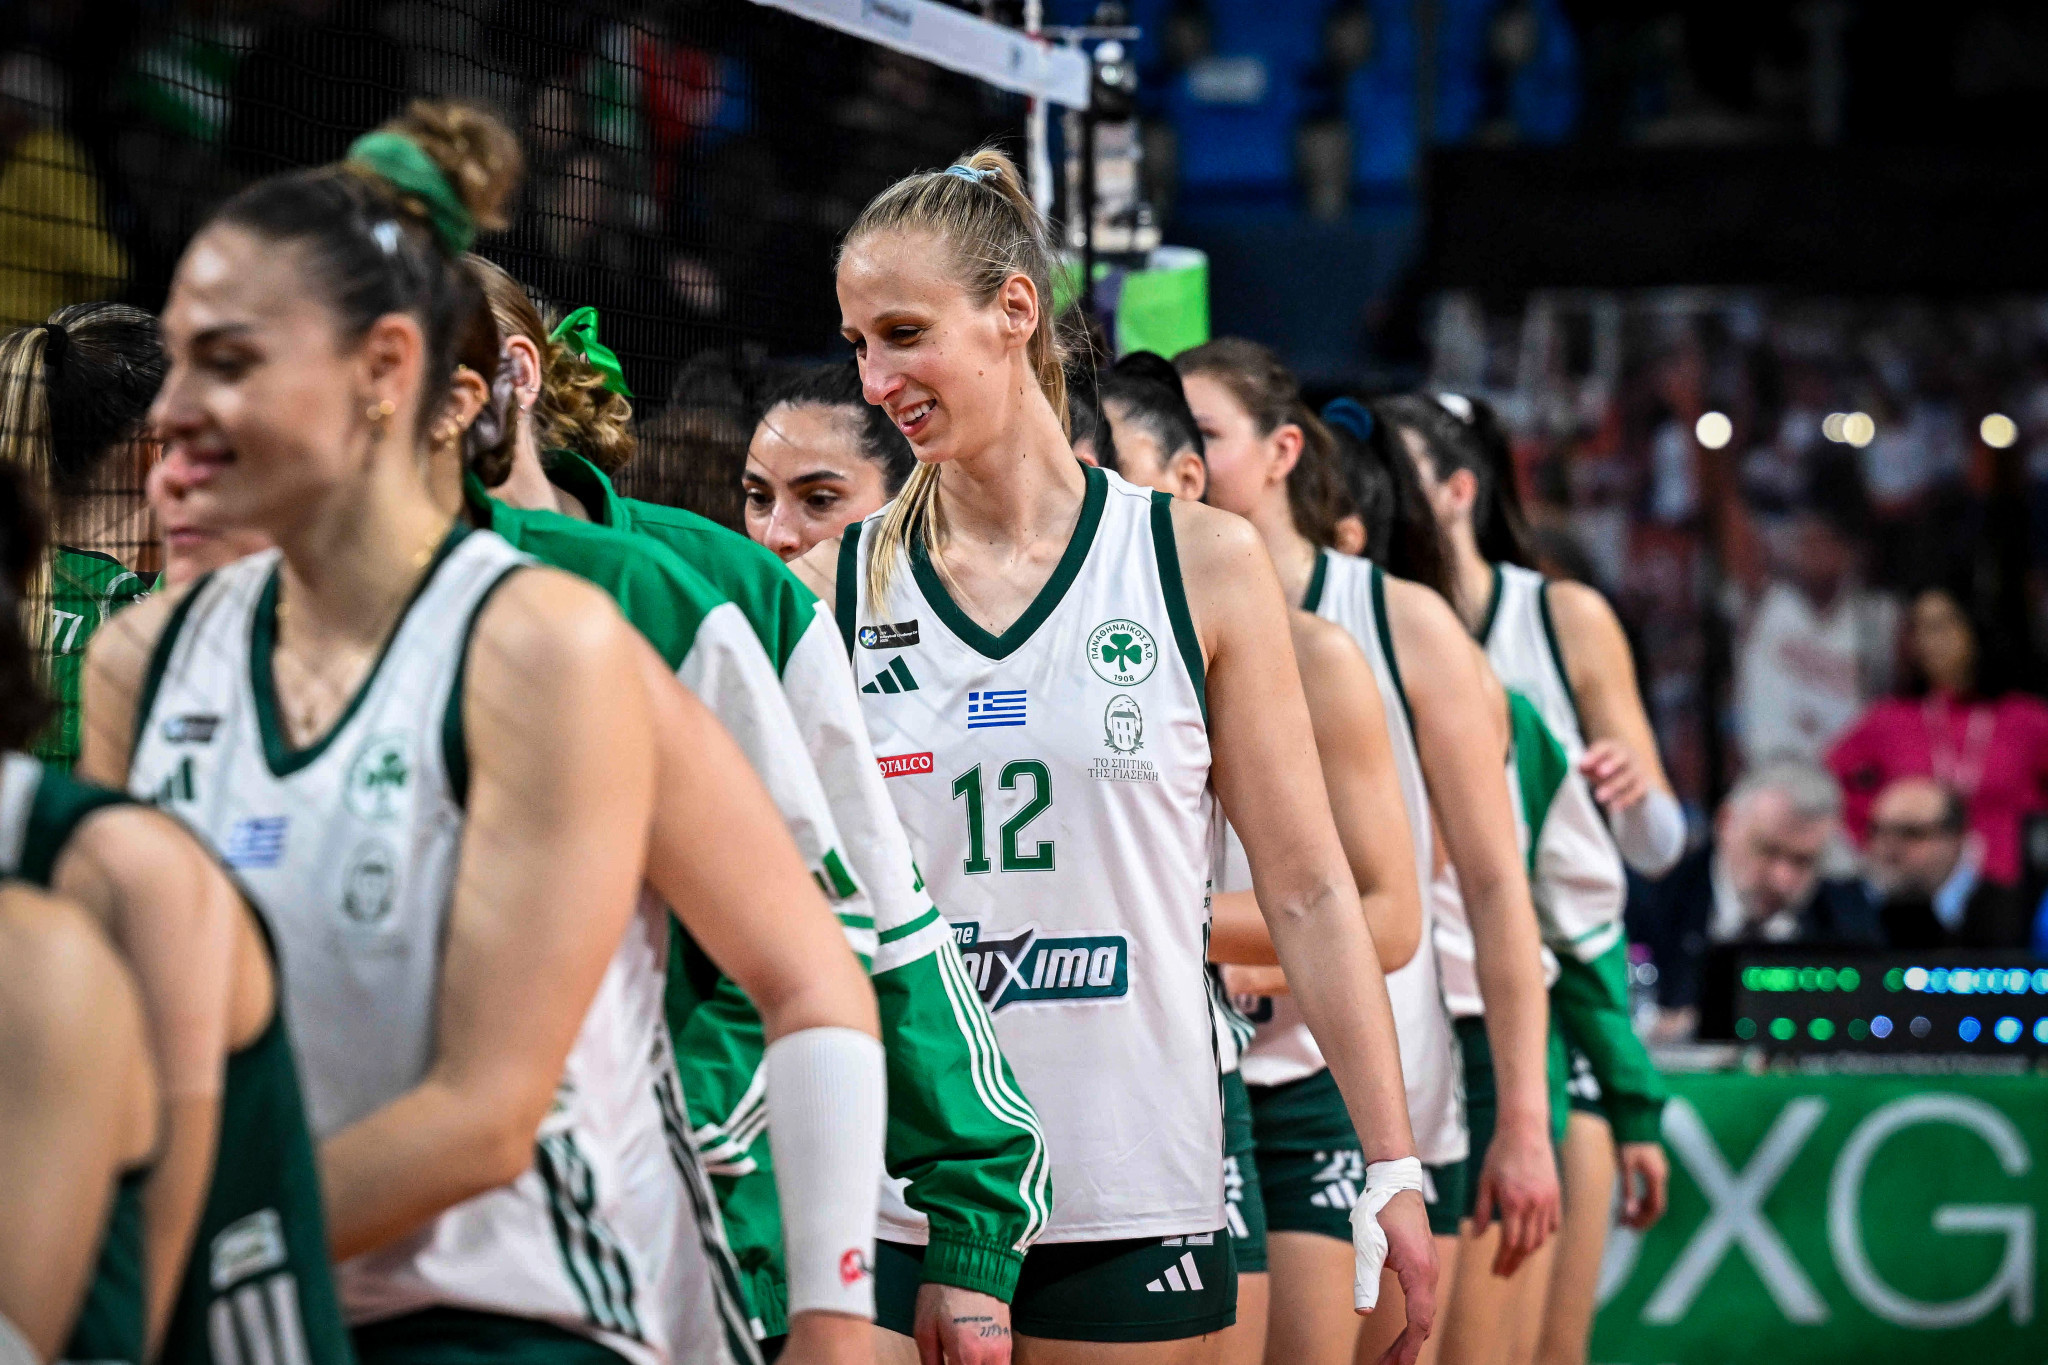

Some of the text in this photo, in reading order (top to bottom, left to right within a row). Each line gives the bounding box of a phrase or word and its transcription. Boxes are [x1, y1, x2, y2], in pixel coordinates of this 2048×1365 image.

[1114, 674, 1135, 683] 1908
[1093, 757, 1153, 771] ΤΟ ΣΠΙΤΙΚΟ
[1087, 768, 1110, 778] ΤΗΣ
[1113, 769, 1159, 782] ΓΙΑΣΕΜΗ
[952, 759, 1055, 875] 12
